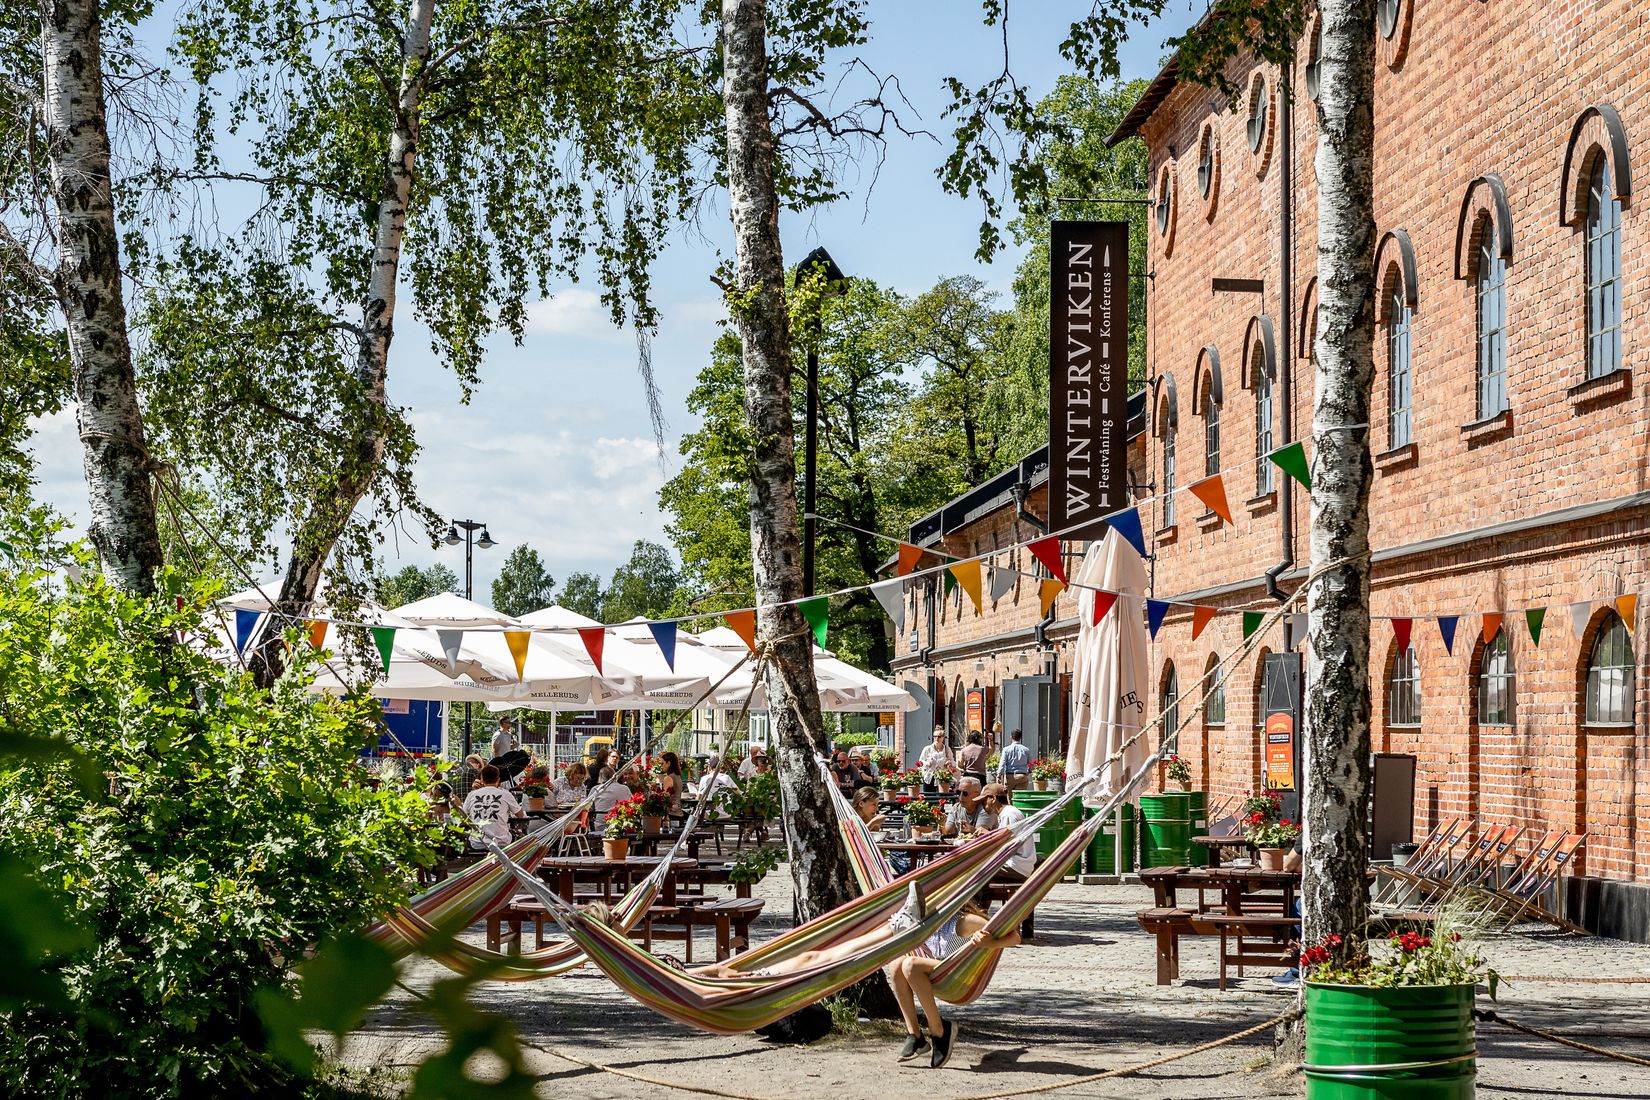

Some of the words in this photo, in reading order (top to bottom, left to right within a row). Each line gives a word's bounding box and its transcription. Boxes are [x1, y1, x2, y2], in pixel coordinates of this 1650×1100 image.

[1098, 272, 1112, 338] Konferens
[1066, 240, 1093, 519] WINTERVIKEN
[1098, 362, 1112, 393] Café
[1098, 419, 1113, 489] Festvåning
[414, 648, 448, 670] LERUDS
[530, 691, 579, 700] MELLERUDS
